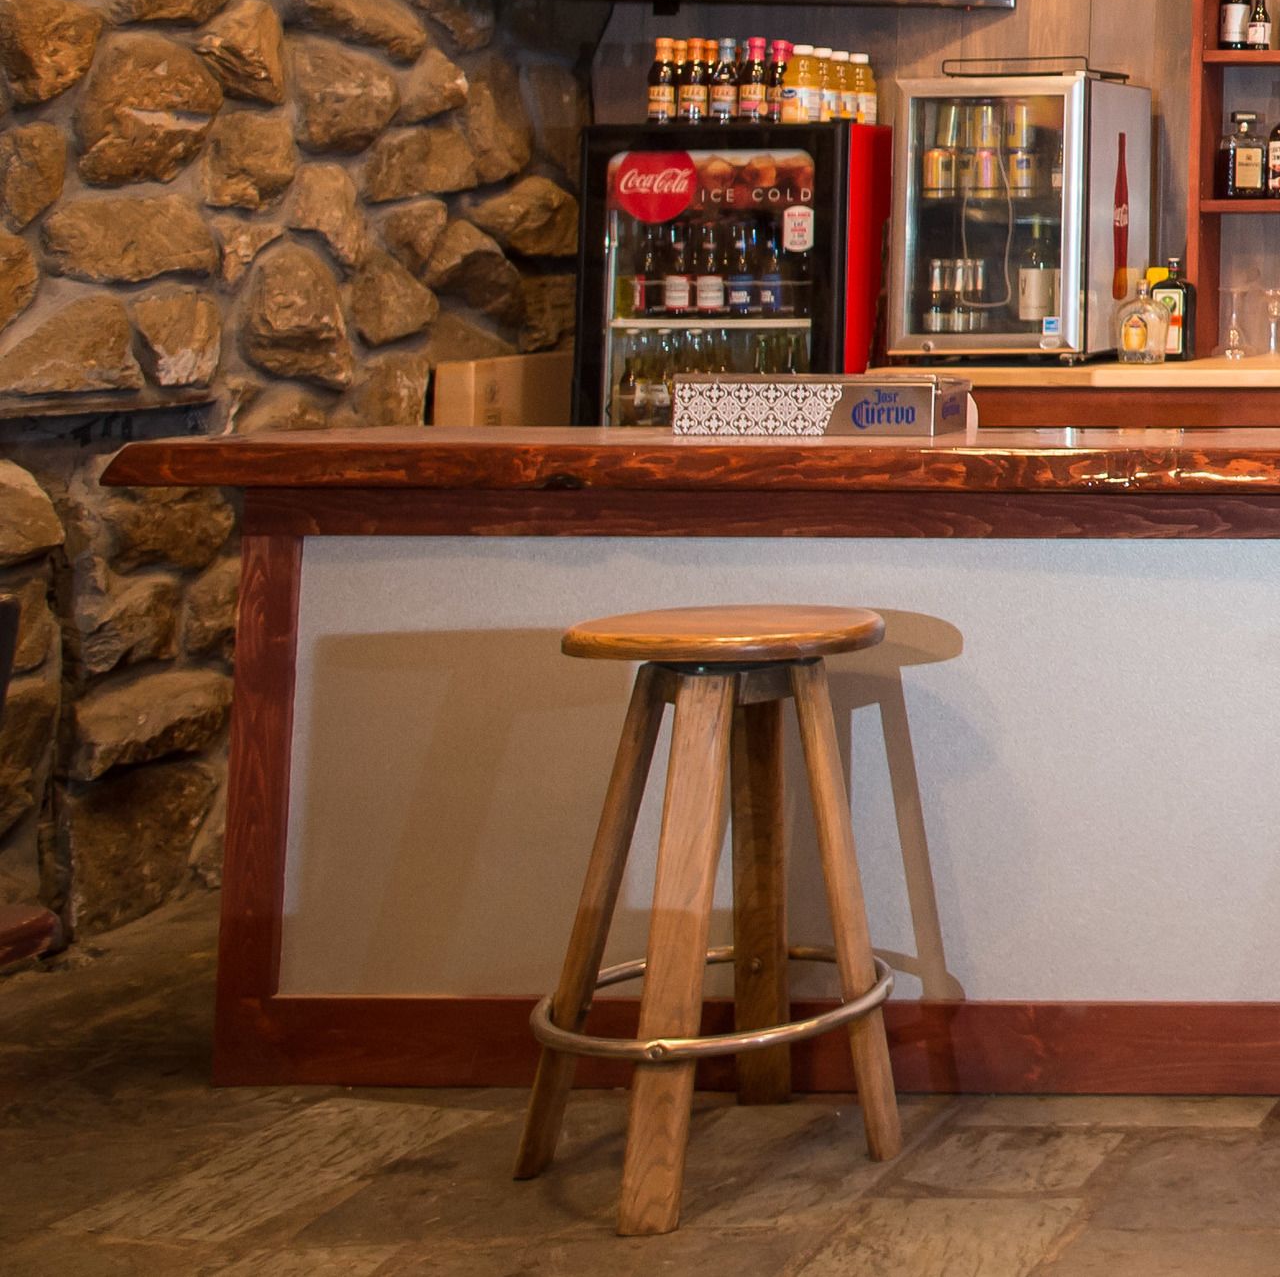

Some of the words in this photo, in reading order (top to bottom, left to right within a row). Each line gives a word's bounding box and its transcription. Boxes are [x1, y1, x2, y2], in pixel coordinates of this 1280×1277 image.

[619, 168, 693, 195] Coca-Cola
[701, 188, 735, 203] ICE
[751, 187, 812, 203] COLD
[851, 399, 916, 429] Cuervo
